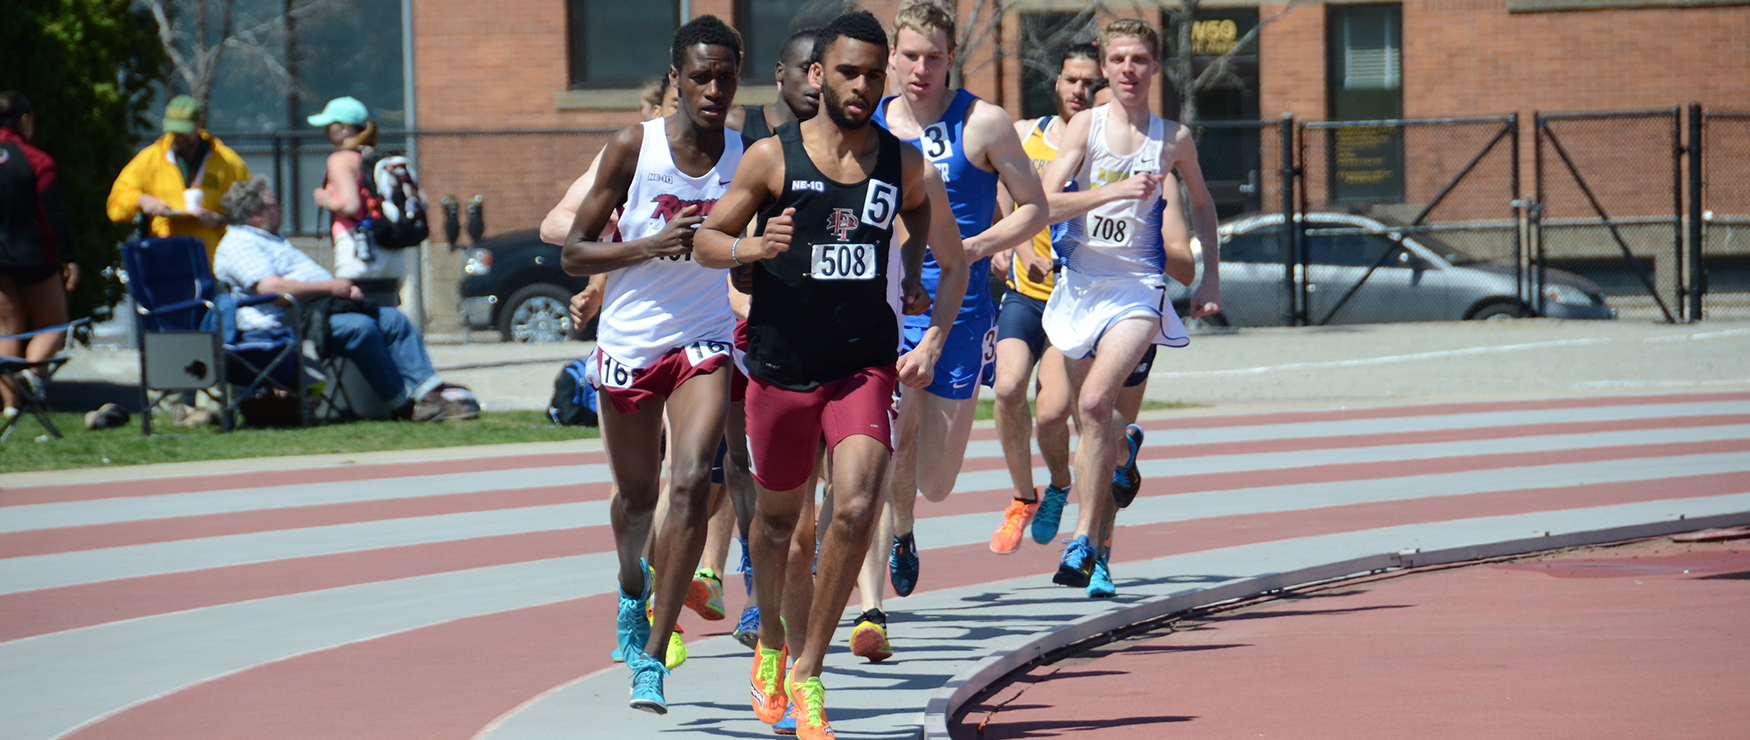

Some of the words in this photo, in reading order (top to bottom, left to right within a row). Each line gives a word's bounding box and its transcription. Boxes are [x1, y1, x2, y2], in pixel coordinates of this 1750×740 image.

[924, 125, 946, 158] 3
[647, 173, 673, 185] NE-10
[791, 180, 825, 193] NE-10
[867, 183, 891, 224] 5
[1092, 214, 1127, 243] 708
[821, 245, 866, 277] 508
[690, 341, 724, 361] 16
[984, 330, 996, 361] 3
[603, 356, 628, 386] 16
